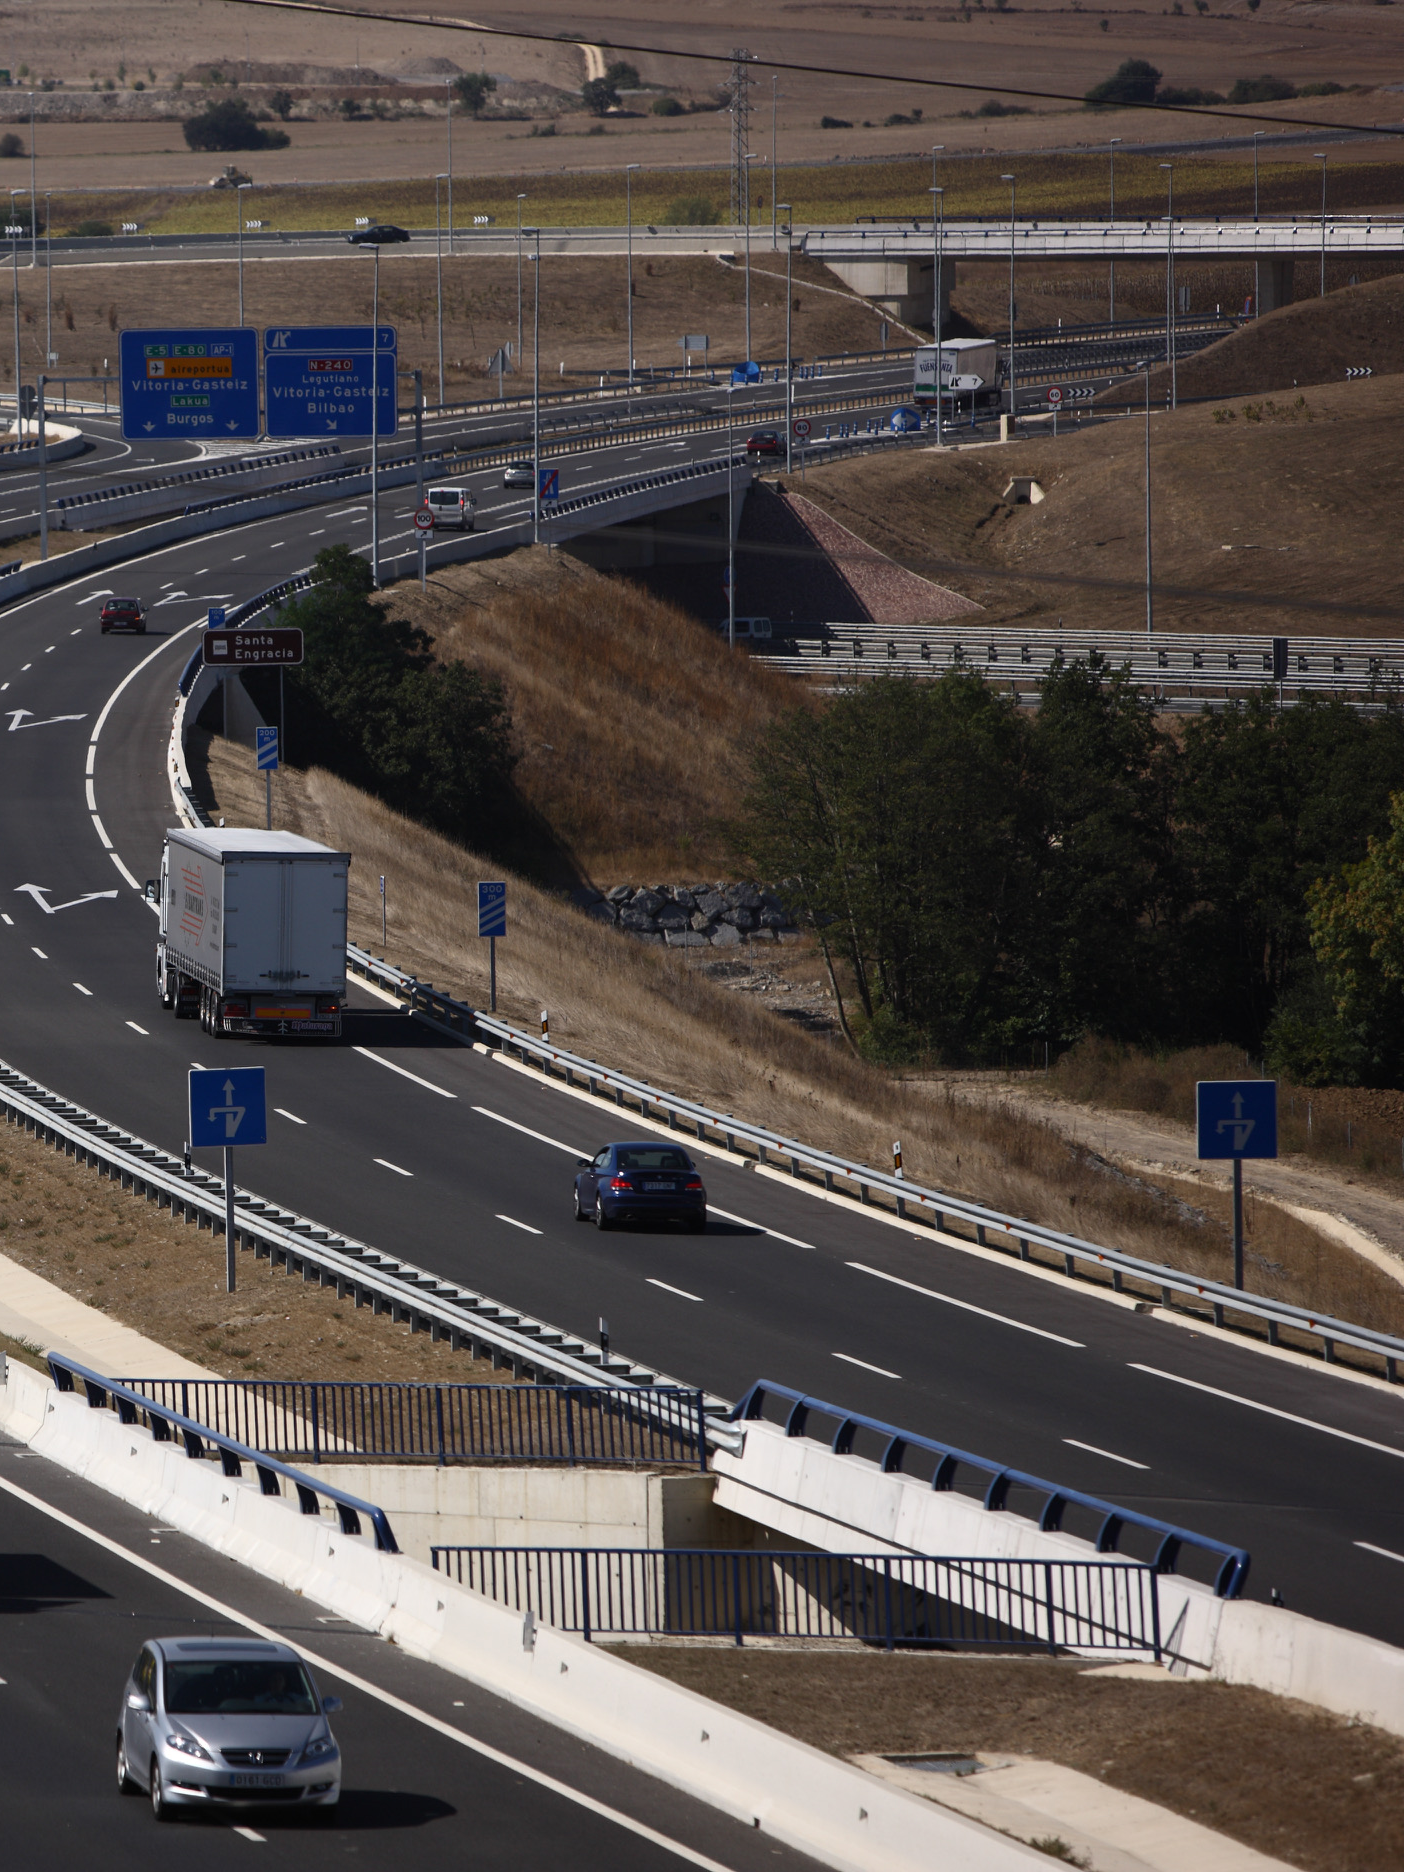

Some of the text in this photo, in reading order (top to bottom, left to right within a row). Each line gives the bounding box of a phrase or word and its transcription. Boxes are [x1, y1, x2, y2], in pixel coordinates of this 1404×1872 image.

[381, 333, 389, 343] 7
[145, 346, 167, 356] E-5
[174, 345, 205, 355] E-80
[213, 345, 233, 354] AP-1
[171, 364, 230, 375] aireportua
[310, 361, 352, 370] N-240
[919, 362, 953, 374] FUENSNTA
[302, 374, 359, 385] Legutiano
[972, 377, 978, 386] 7
[132, 379, 249, 391] Vitoria-Gasteiz
[273, 386, 390, 398] Vitoria-Gasteiz
[172, 396, 209, 406] Lakua
[308, 402, 355, 414] Bilbao
[167, 413, 214, 427] Burgos
[235, 636, 274, 645] Santa
[235, 648, 294, 661] Engracia
[482, 885, 503, 893] 300
